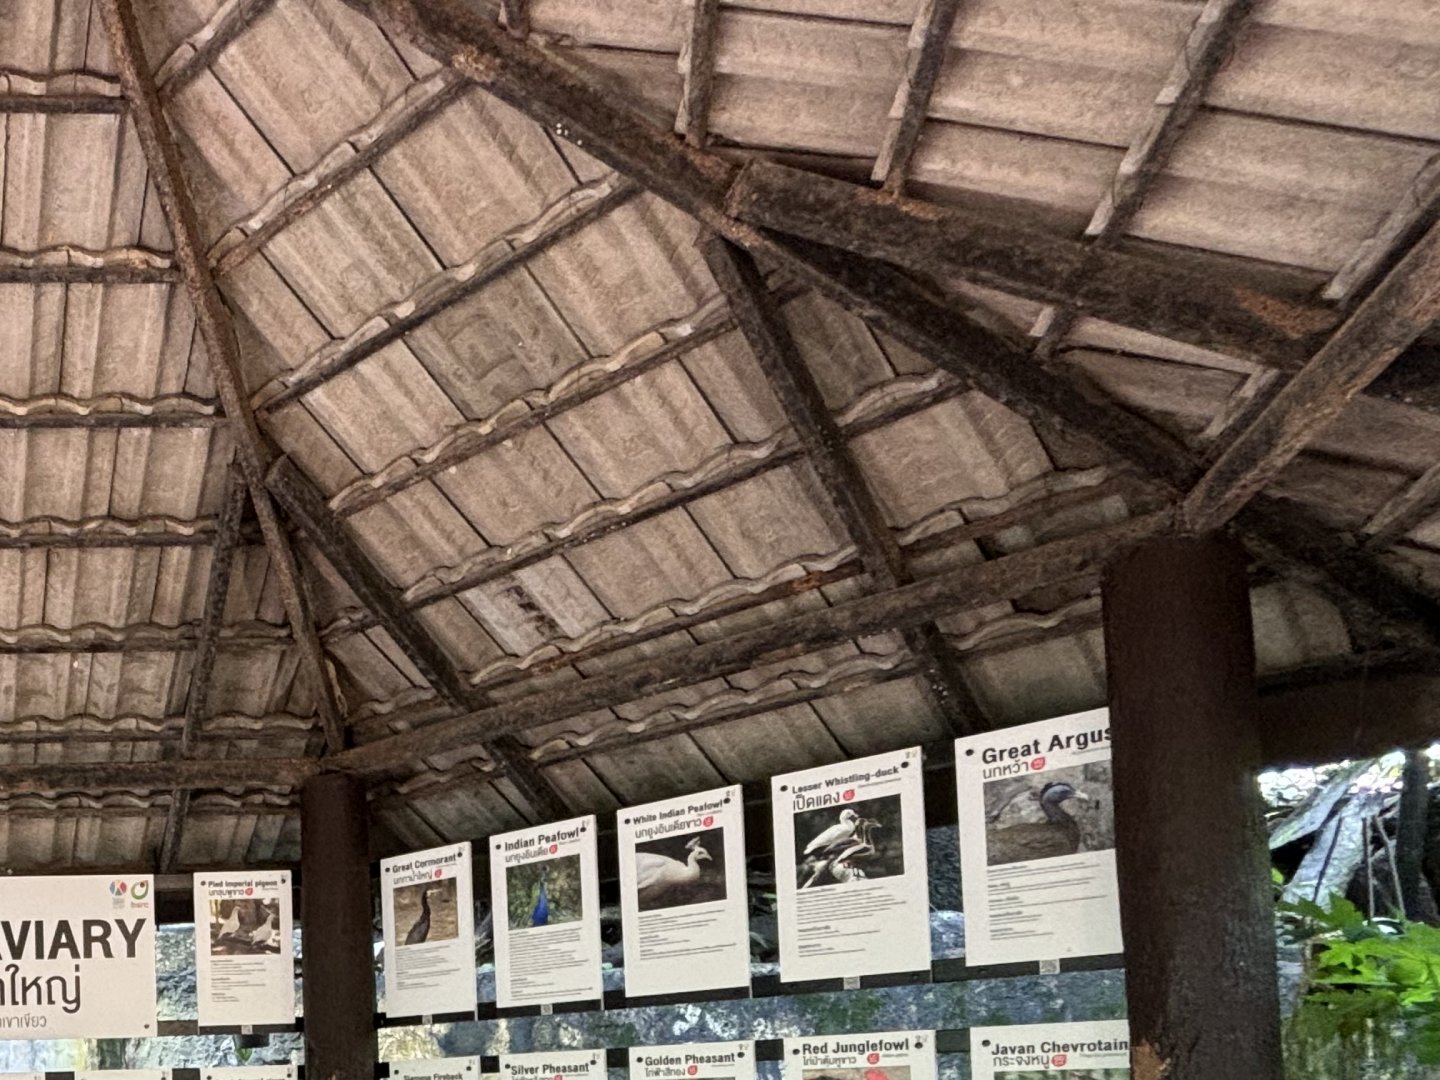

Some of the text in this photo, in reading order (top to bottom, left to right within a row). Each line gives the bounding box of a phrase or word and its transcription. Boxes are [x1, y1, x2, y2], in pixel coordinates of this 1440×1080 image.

[982, 739, 1041, 764] Great
[792, 782, 822, 794] Lesser
[824, 766, 900, 788] Whistling-duck
[982, 759, 1029, 780] นกหว้า
[793, 791, 841, 811] เป็ดแดง
[633, 799, 722, 825] White Indian Peafowl
[504, 827, 579, 852] Indian Peafowl
[392, 852, 456, 873] Great Cormorant
[802, 1037, 910, 1056] Red Junglefowl
[991, 1037, 1129, 1055] Javan Chevrotain
[511, 1063, 590, 1076] Silver Pheasant
[644, 1052, 736, 1066] Golden Pheasant
